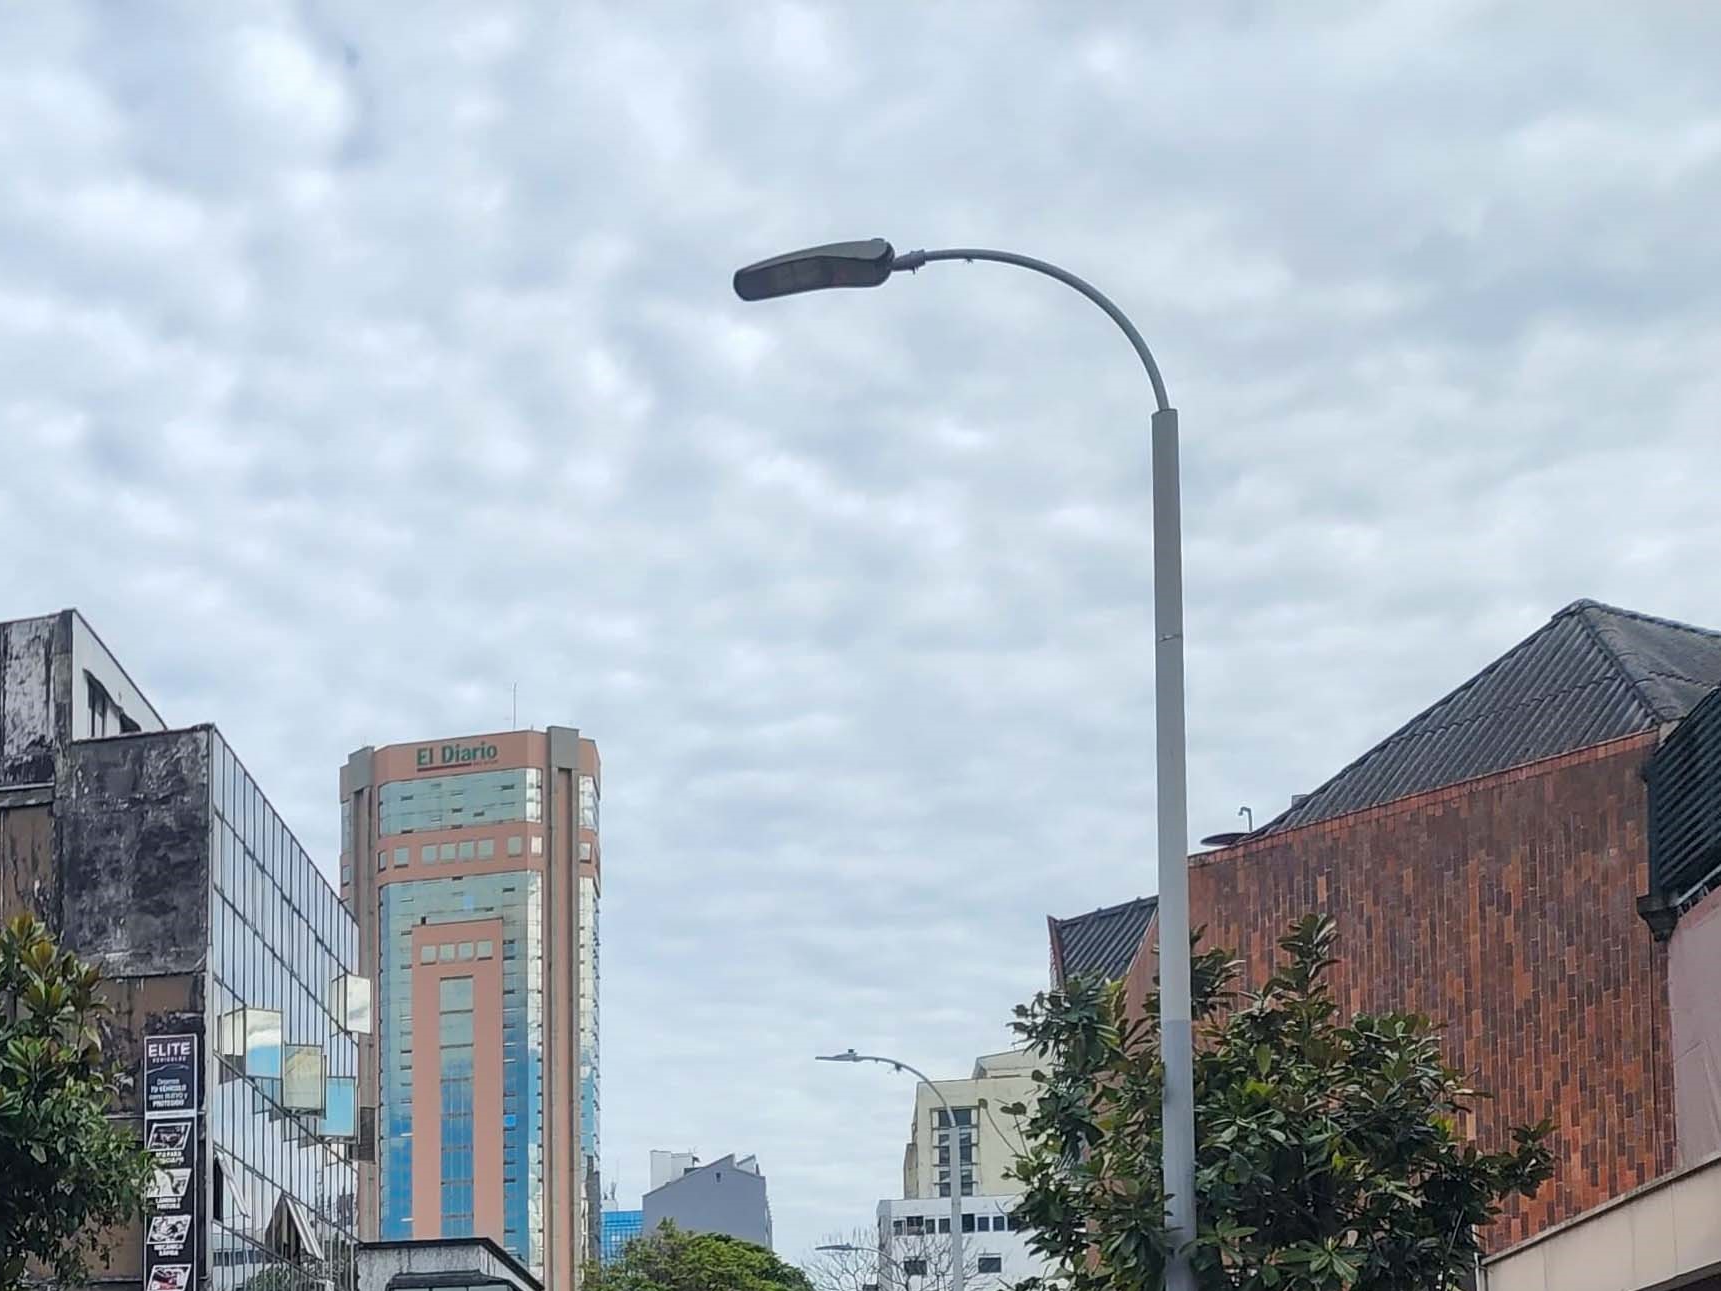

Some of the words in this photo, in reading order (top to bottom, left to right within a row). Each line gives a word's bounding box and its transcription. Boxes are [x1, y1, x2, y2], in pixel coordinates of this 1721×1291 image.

[416, 747, 433, 766] El
[441, 741, 498, 765] Diario
[148, 1042, 191, 1057] ELITE
